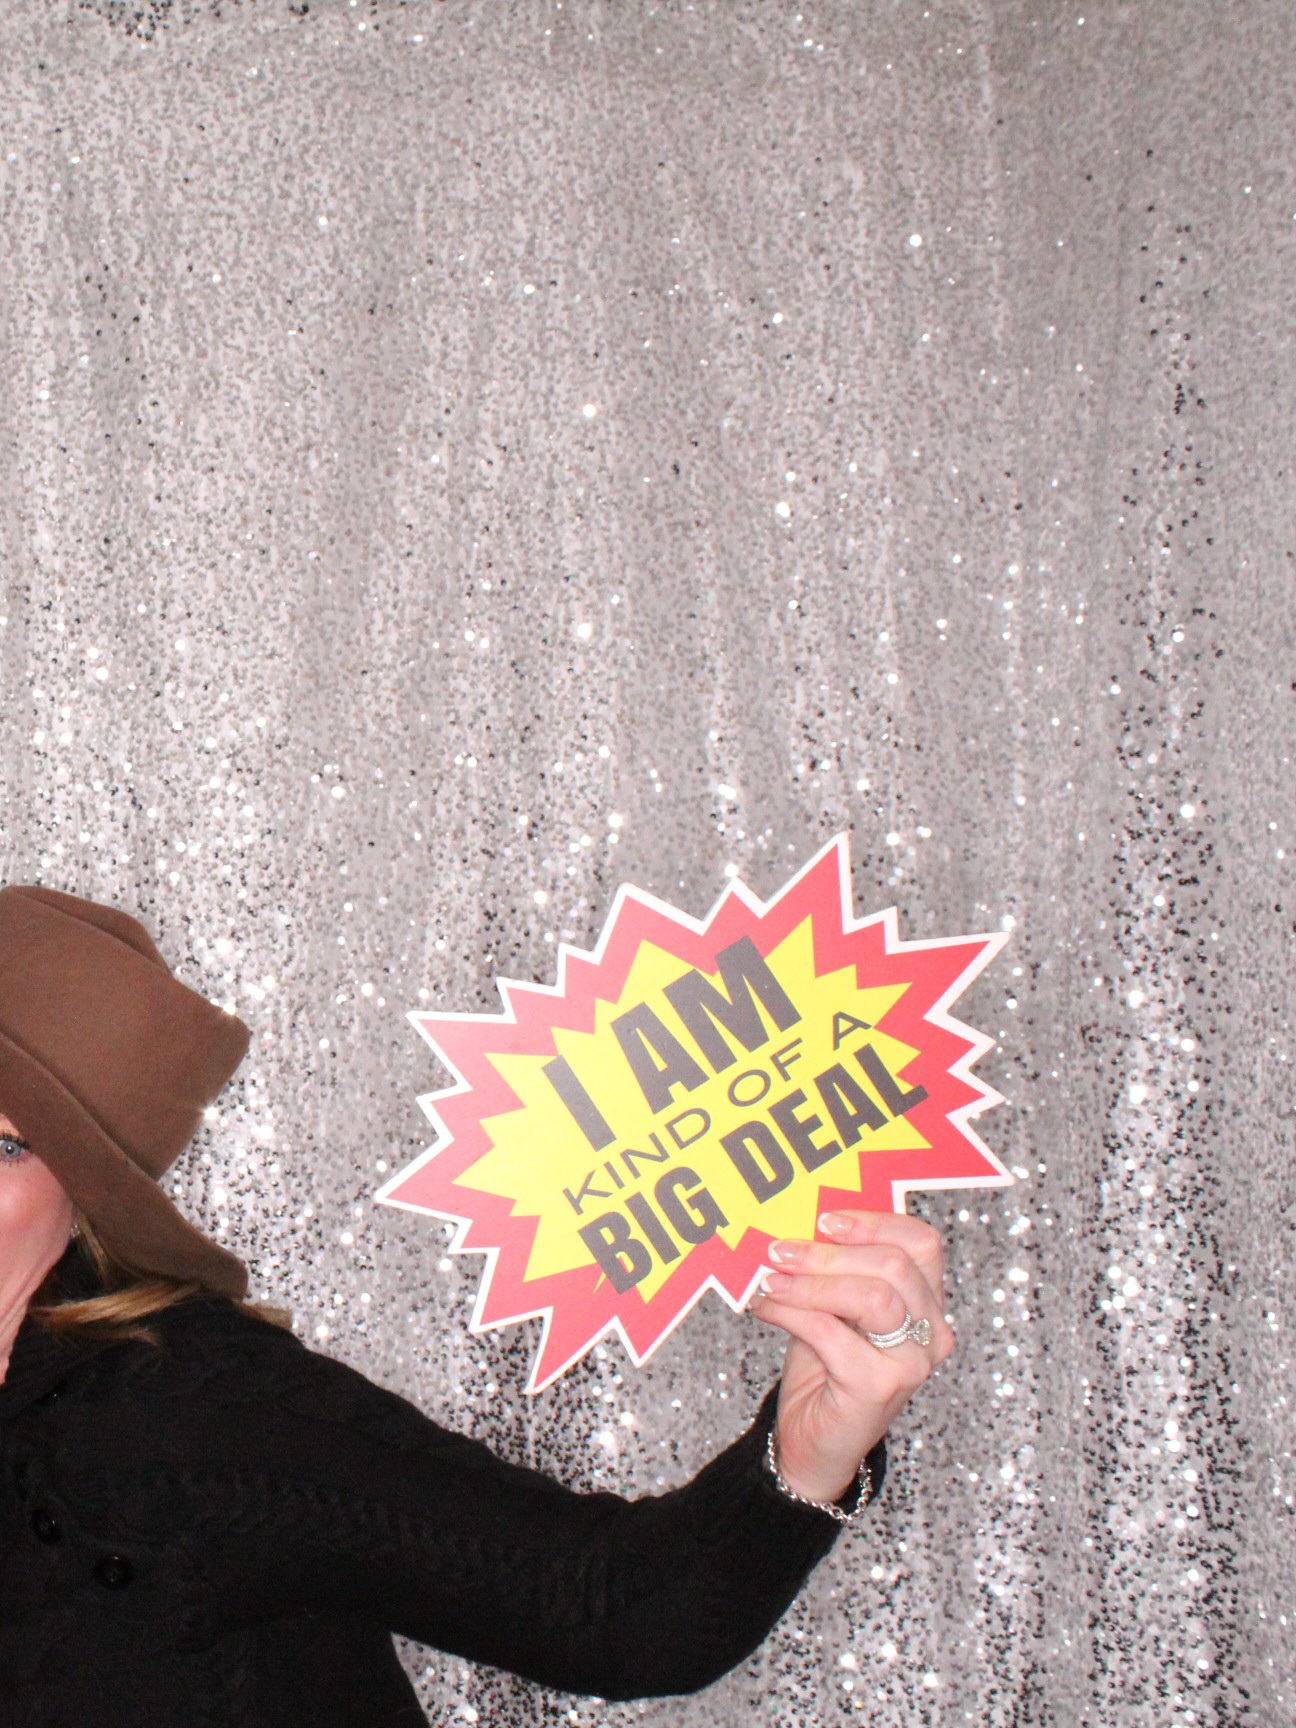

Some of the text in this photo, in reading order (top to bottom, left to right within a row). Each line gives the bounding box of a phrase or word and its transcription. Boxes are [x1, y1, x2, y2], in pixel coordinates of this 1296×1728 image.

[541, 935, 802, 1152] I AM
[562, 1011, 873, 1216] KIND OF A
[577, 1043, 930, 1296] BIG DEAL
